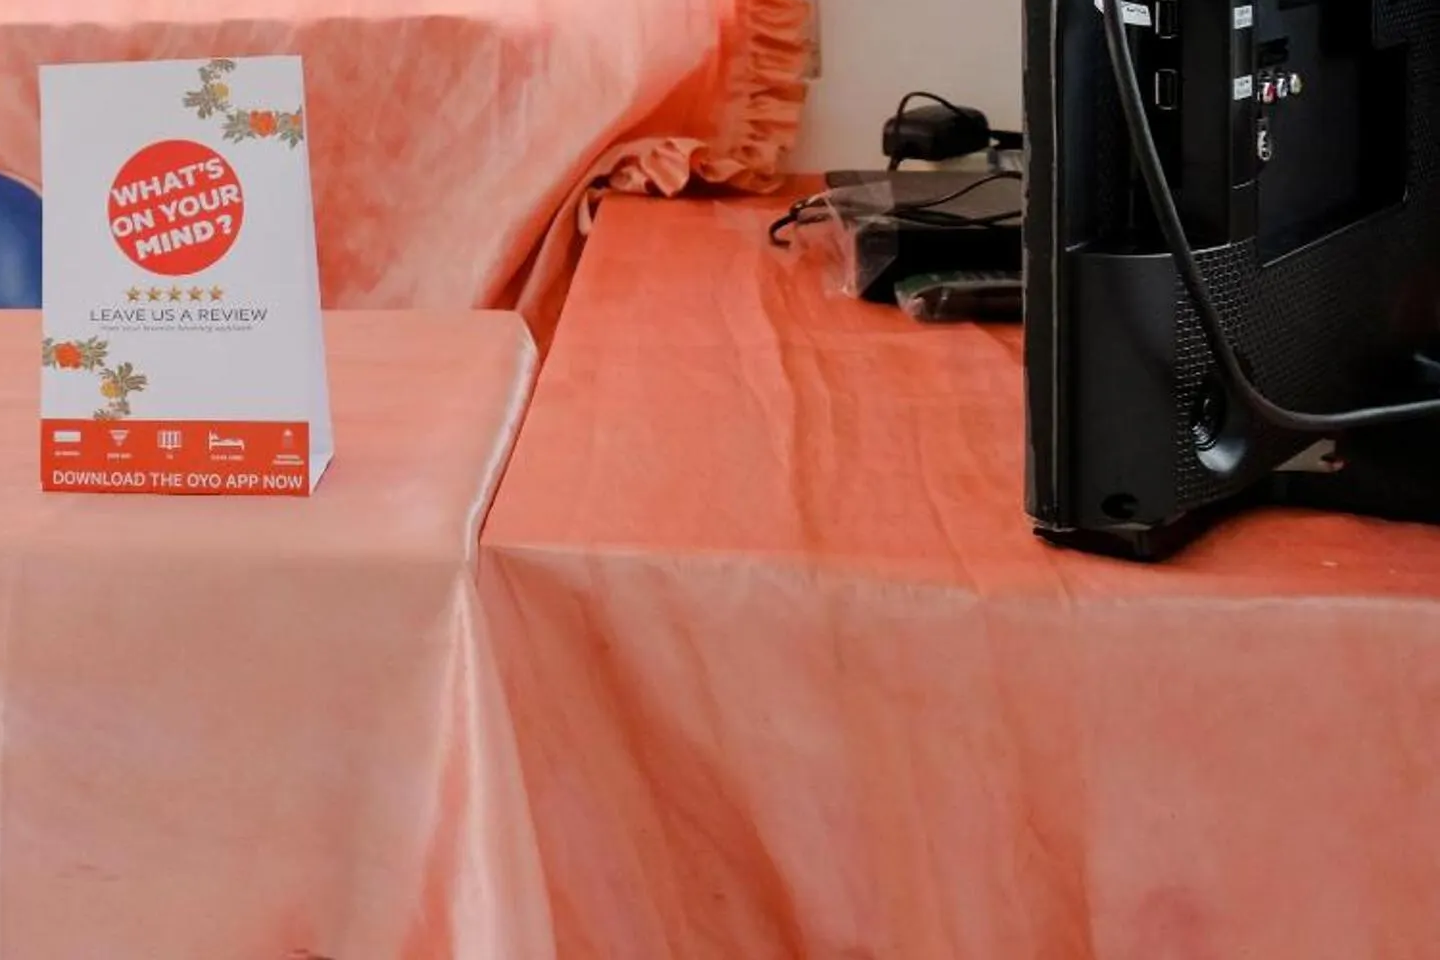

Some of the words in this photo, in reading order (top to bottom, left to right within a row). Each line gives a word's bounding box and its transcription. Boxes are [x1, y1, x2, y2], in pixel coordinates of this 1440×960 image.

[111, 157, 225, 208] WHAT'S
[112, 208, 155, 238] ON
[158, 183, 242, 223] YOUR
[135, 214, 233, 260] MIND?
[89, 308, 146, 322] LEAVE
[151, 308, 175, 322] US
[179, 308, 194, 322] A
[198, 308, 268, 322] REVIEW
[52, 470, 146, 486] DOWNLOAD
[149, 471, 183, 487] THE
[186, 472, 222, 488] OYO
[225, 473, 259, 489] APP
[262, 474, 303, 489] NOW
